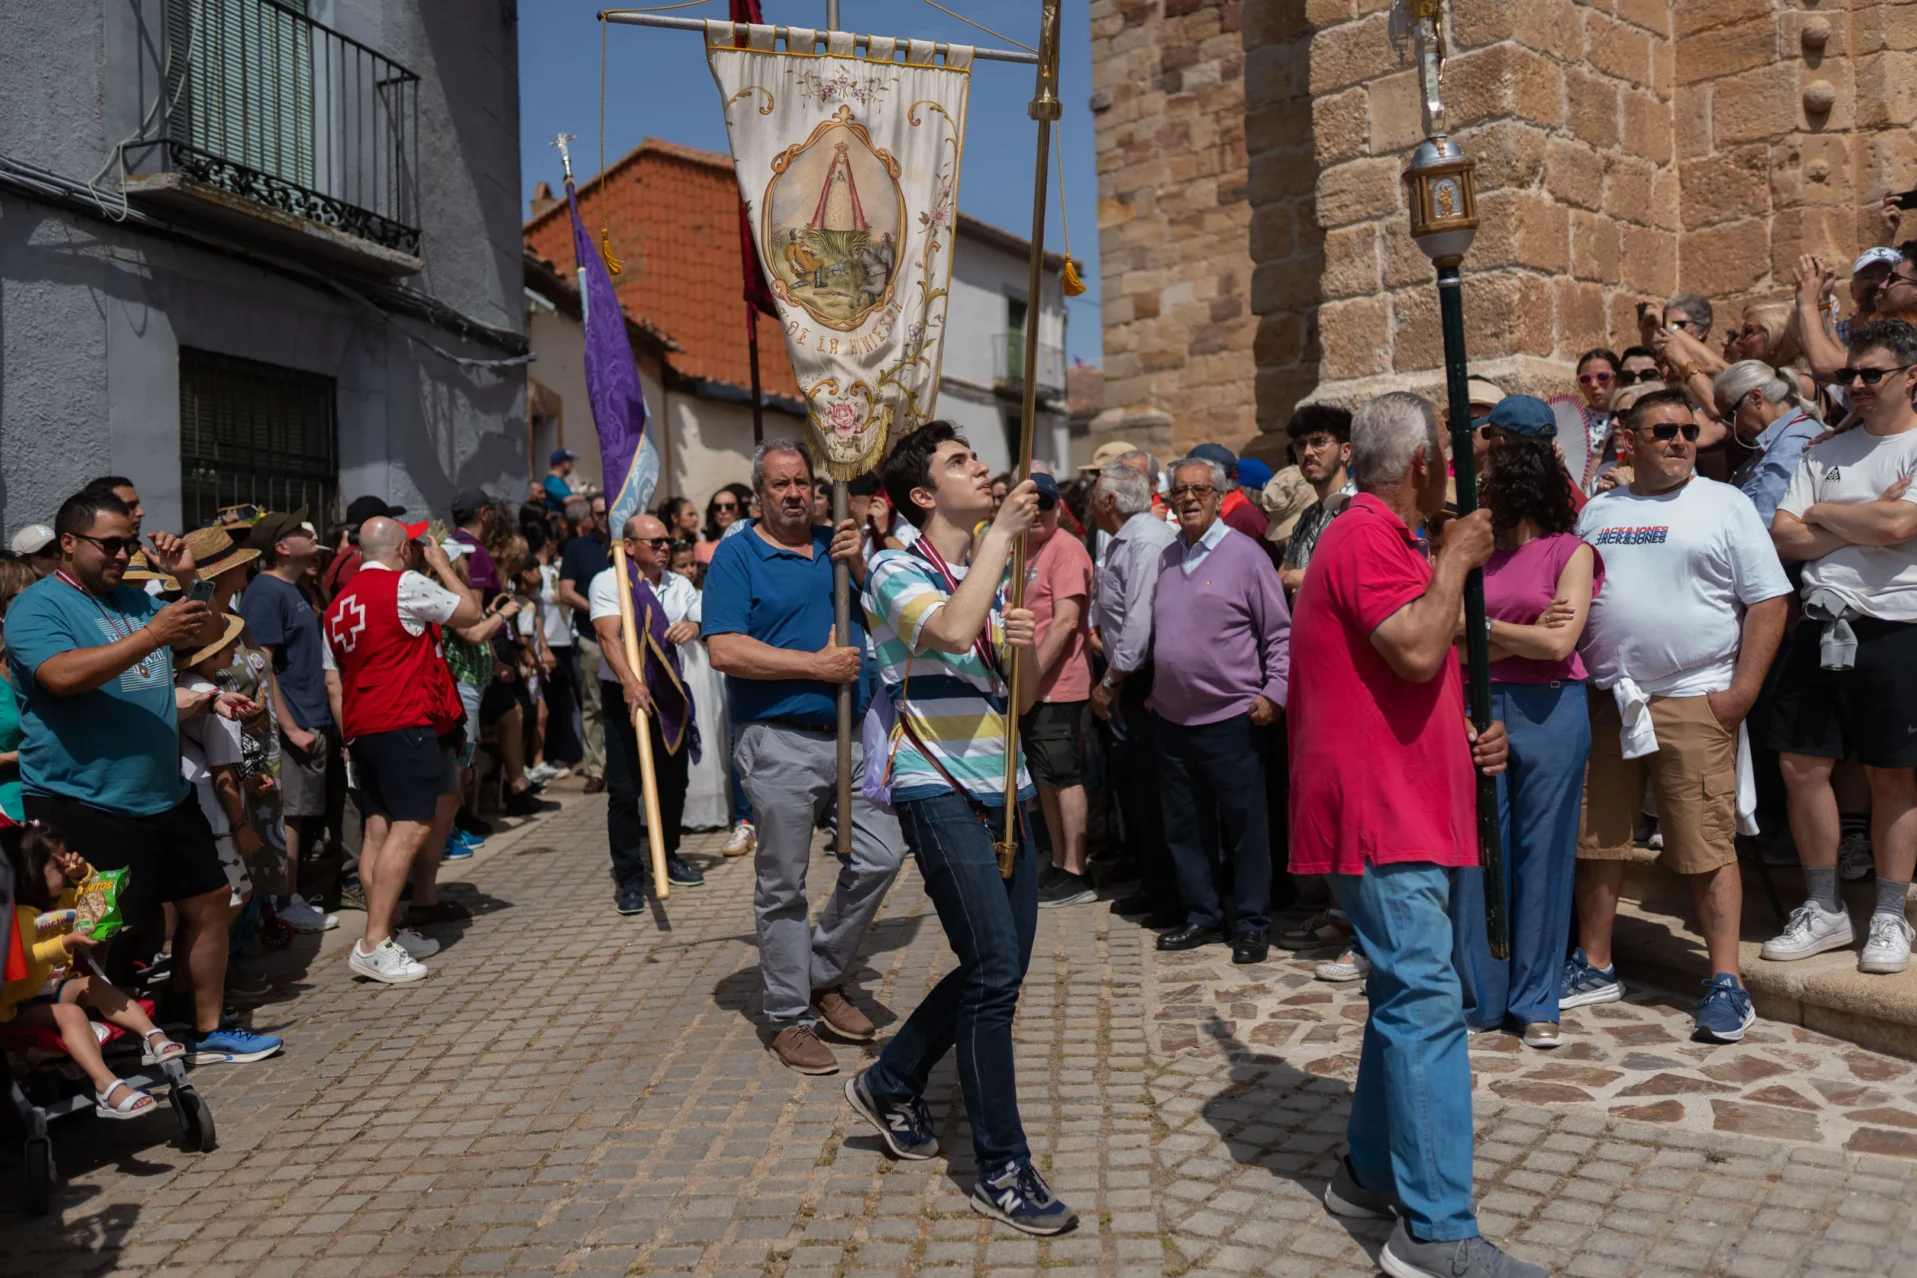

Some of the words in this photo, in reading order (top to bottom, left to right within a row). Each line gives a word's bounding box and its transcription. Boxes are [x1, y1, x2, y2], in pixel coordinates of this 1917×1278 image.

[786, 320, 811, 346] DE
[816, 335, 839, 355] LA
[1595, 535, 1666, 546] JACK&JONES
